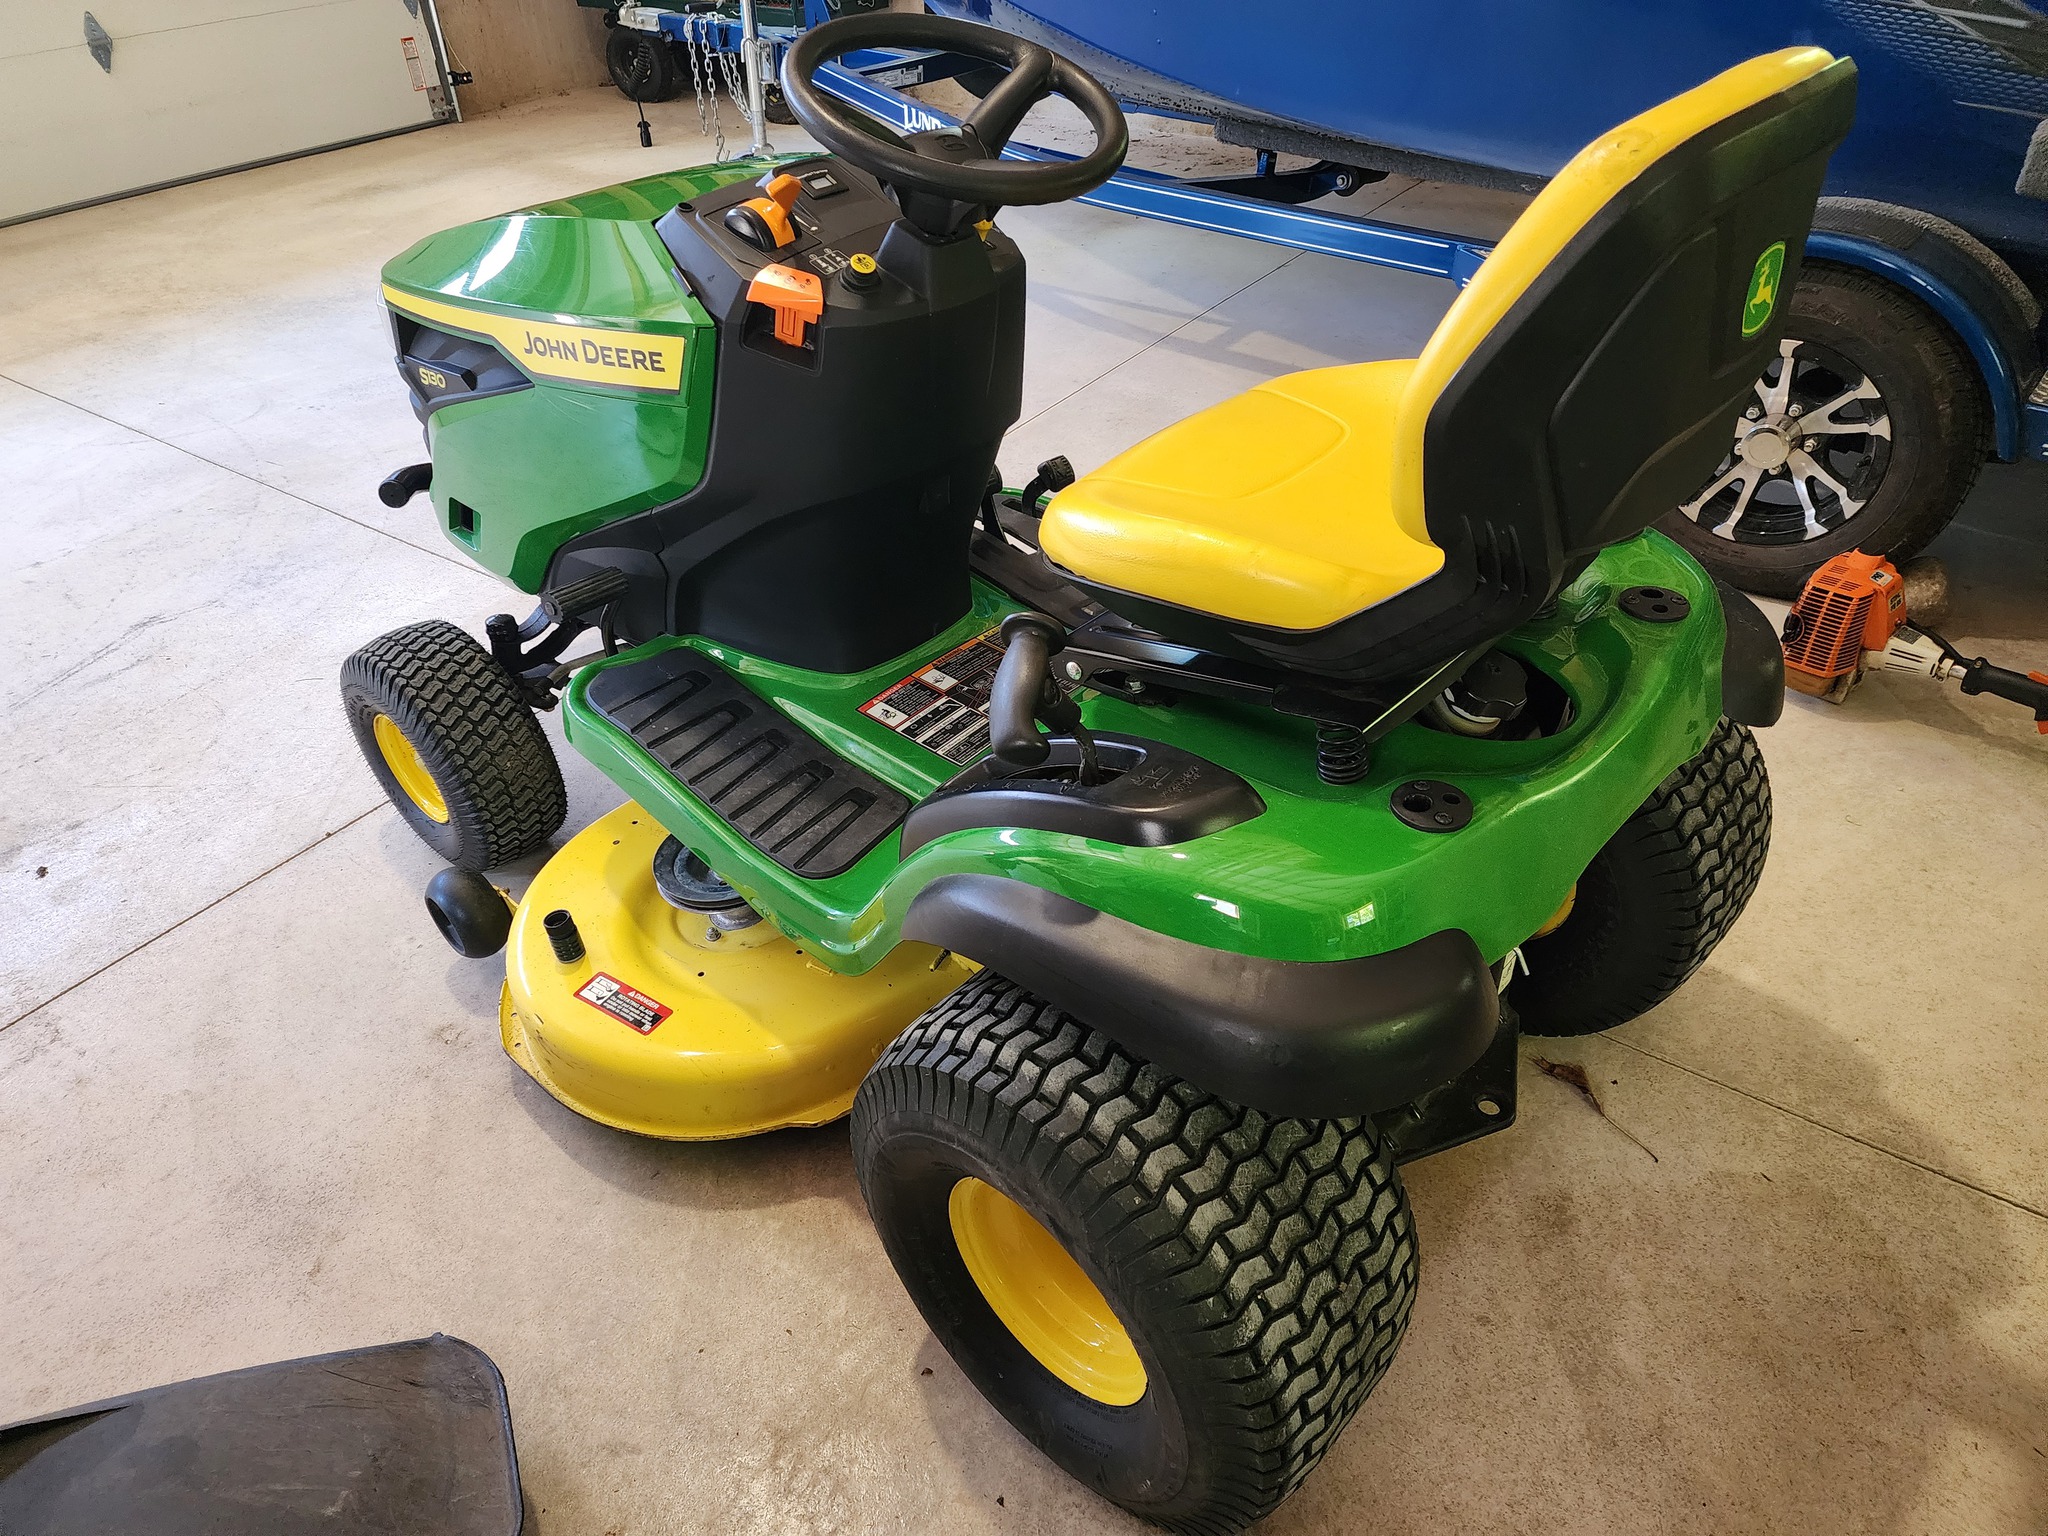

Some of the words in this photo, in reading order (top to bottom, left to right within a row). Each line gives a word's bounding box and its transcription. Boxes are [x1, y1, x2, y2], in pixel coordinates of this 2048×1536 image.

[524, 331, 579, 362] JOHN
[581, 339, 666, 373] DEERE
[419, 367, 446, 389] S130
[634, 993, 660, 1009] DANGER
